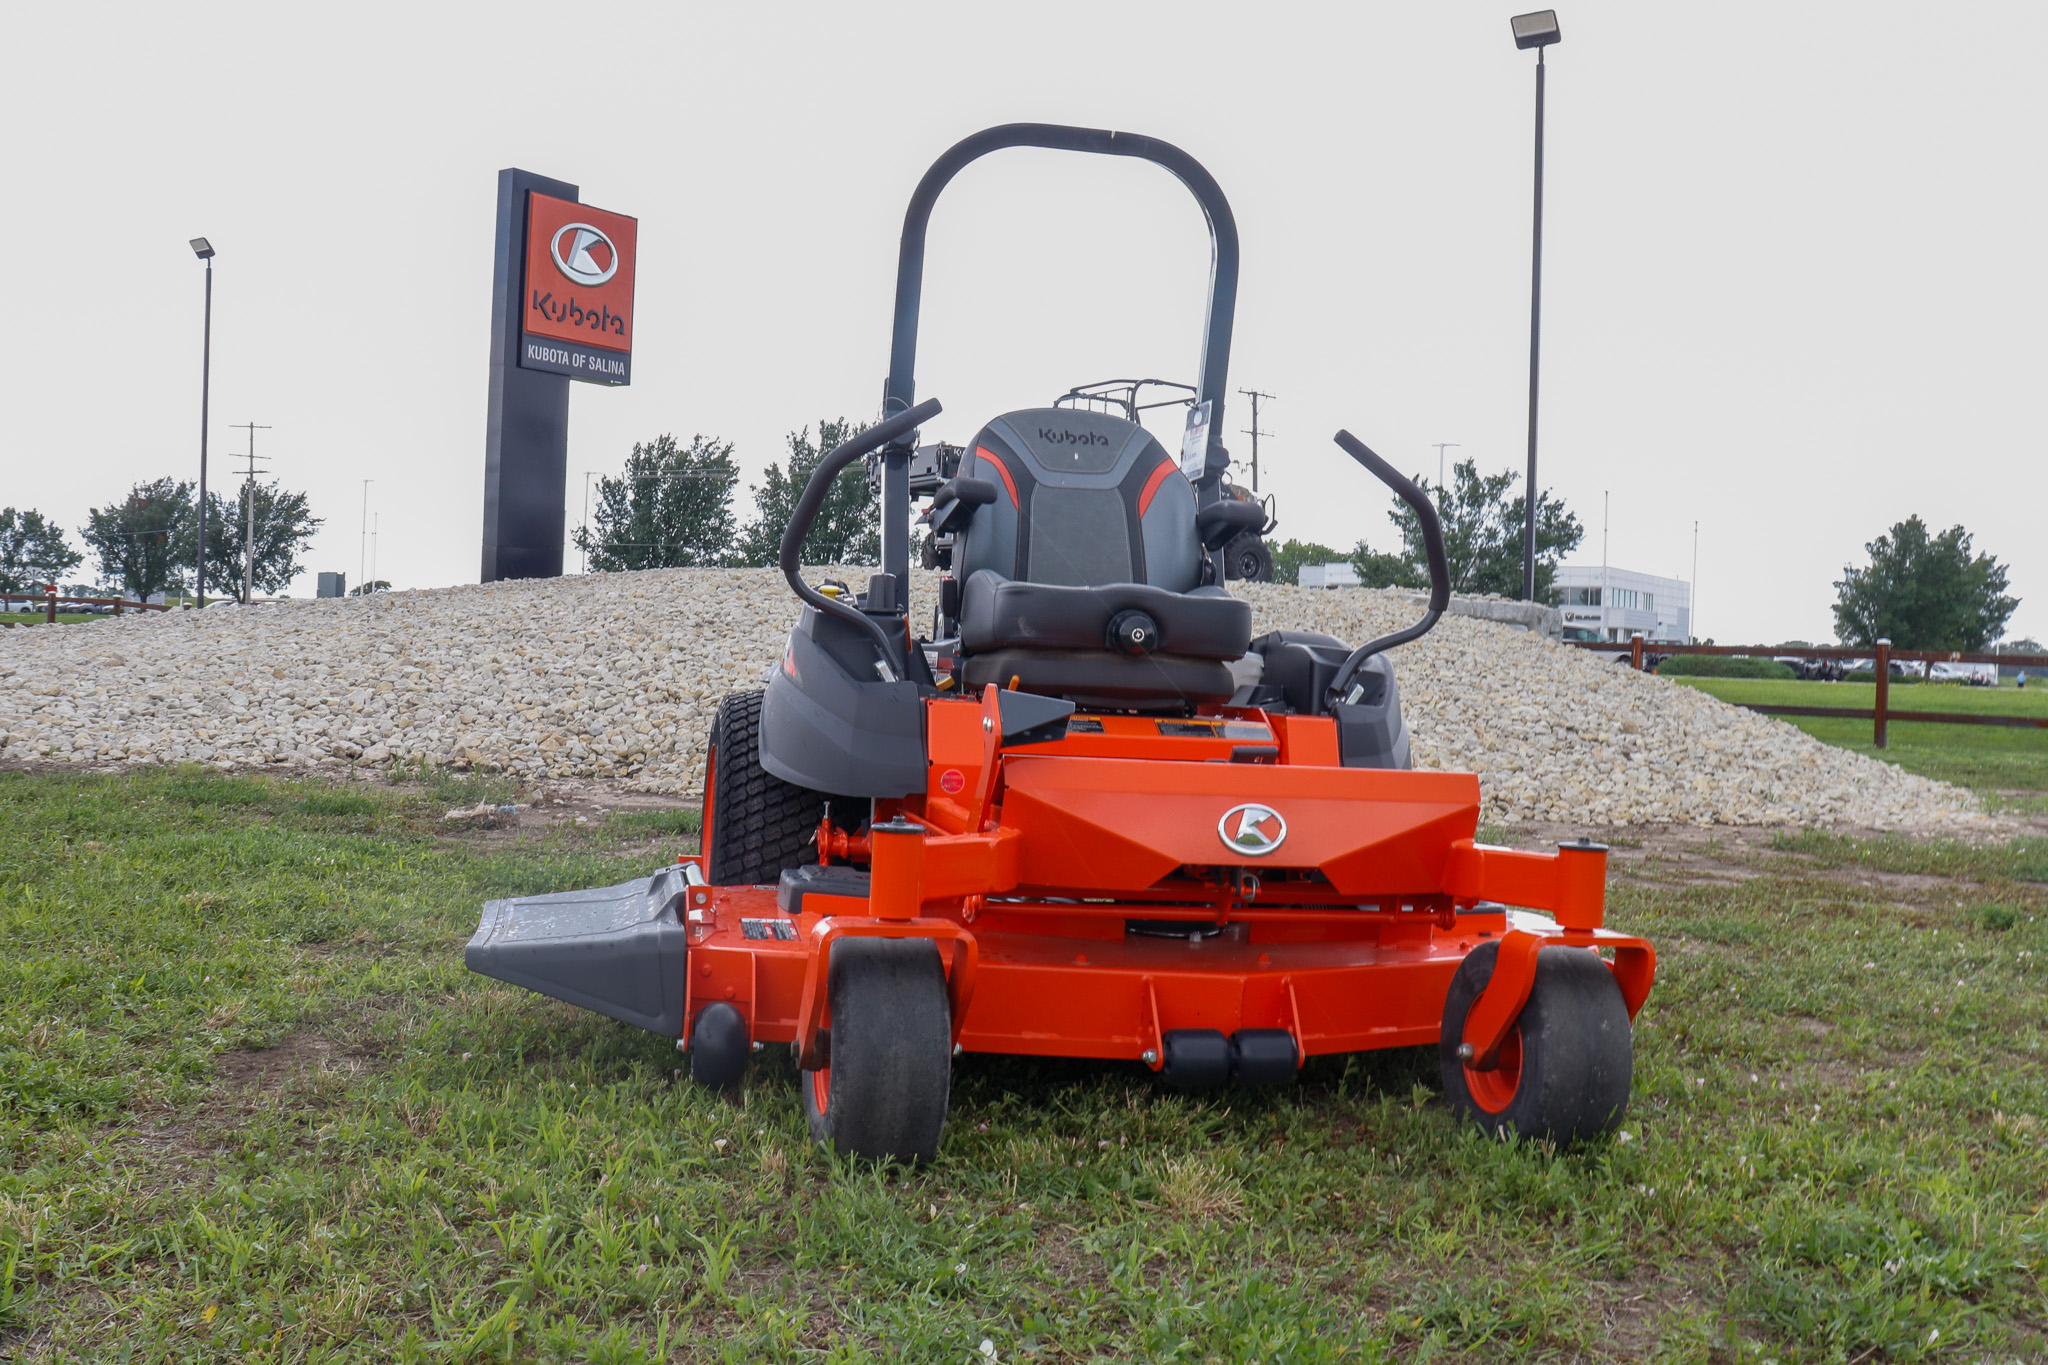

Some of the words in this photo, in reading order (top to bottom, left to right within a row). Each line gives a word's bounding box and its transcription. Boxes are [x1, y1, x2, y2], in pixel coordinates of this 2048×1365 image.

[533, 289, 625, 335] Kubota
[527, 344, 569, 366] KUBOTA
[572, 353, 586, 368] OF
[588, 356, 625, 376] SALINA
[1038, 428, 1109, 446] Kubota
